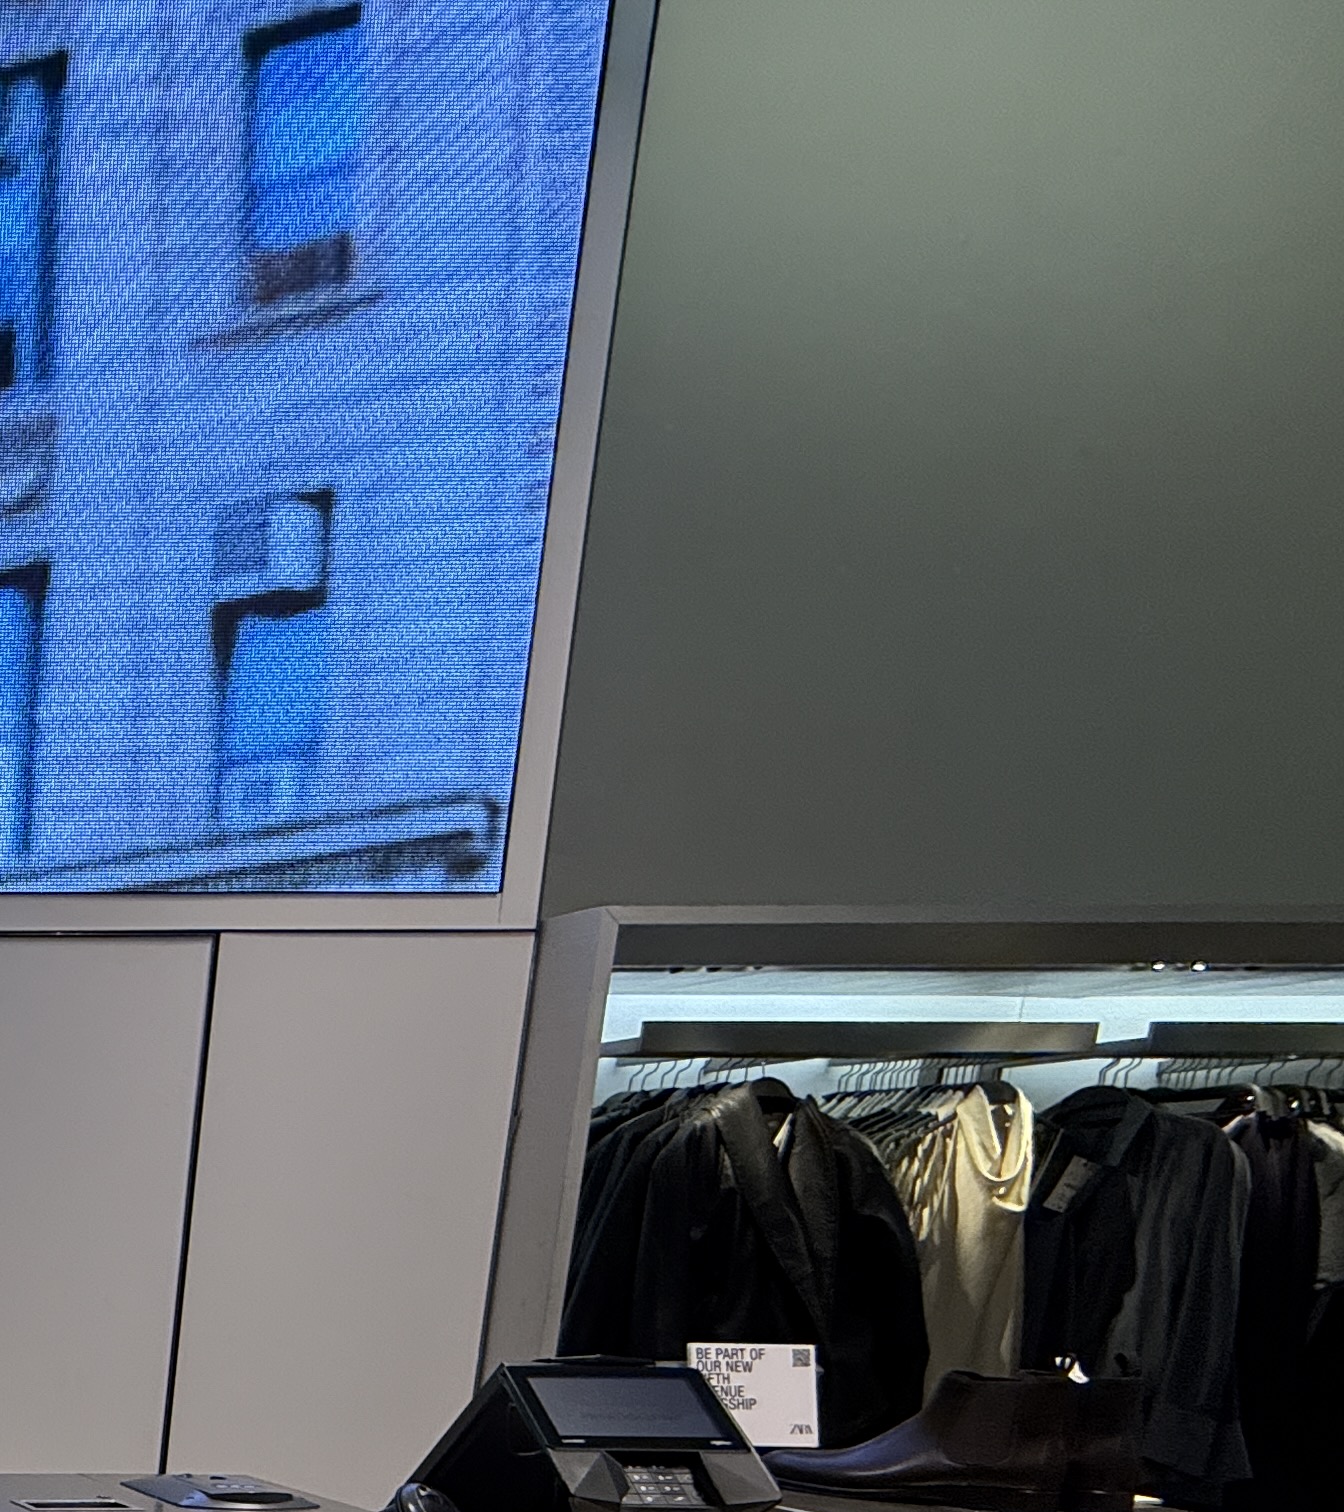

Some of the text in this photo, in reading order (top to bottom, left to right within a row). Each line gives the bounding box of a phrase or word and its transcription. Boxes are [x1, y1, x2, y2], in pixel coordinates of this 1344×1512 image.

[696, 1347, 766, 1361] BE PART OF
[697, 1360, 753, 1373] OUR NEW
[713, 1385, 745, 1398] ENUE
[721, 1398, 757, 1411] GSHIP
